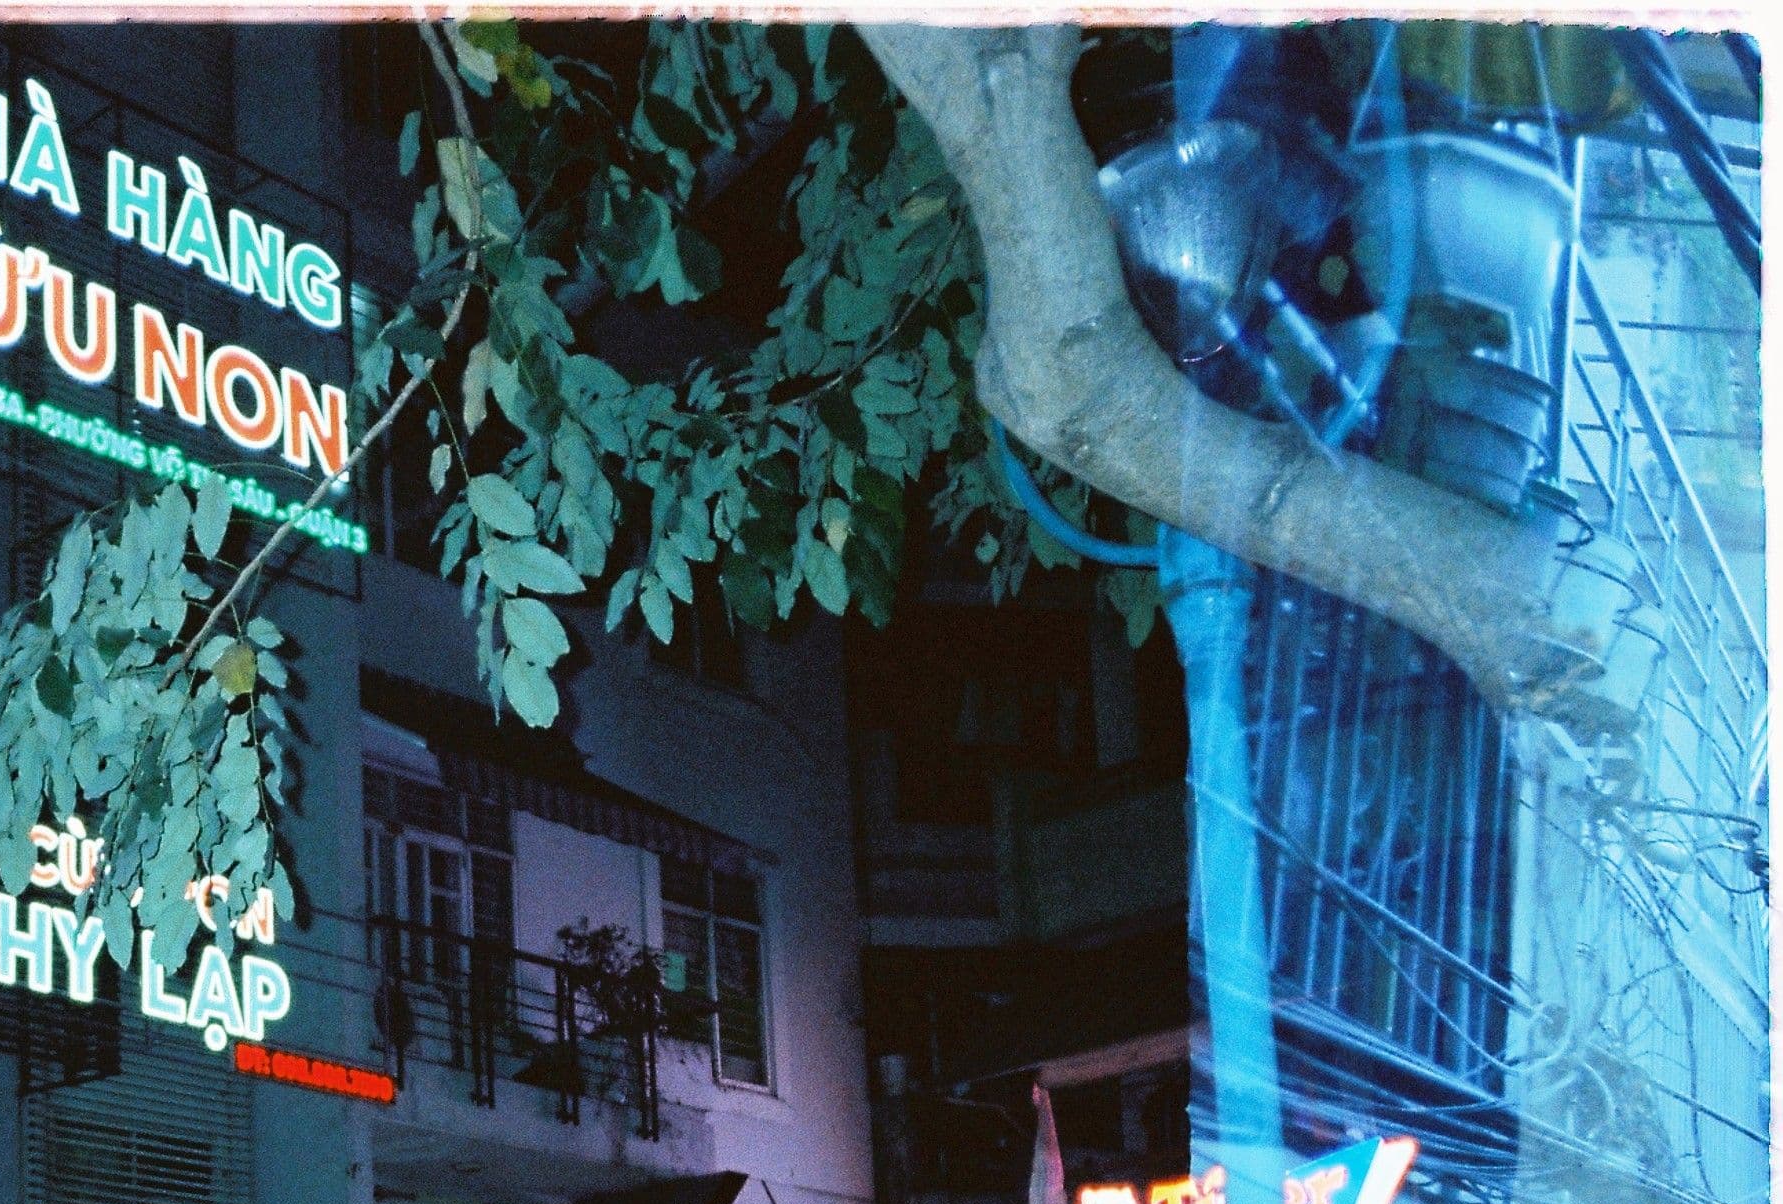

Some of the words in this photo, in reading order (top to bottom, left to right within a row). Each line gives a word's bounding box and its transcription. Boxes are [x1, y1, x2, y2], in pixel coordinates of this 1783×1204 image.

[108, 150, 341, 328] HÀNG
[135, 304, 349, 482] NON
[141, 929, 291, 1051] LẠP
